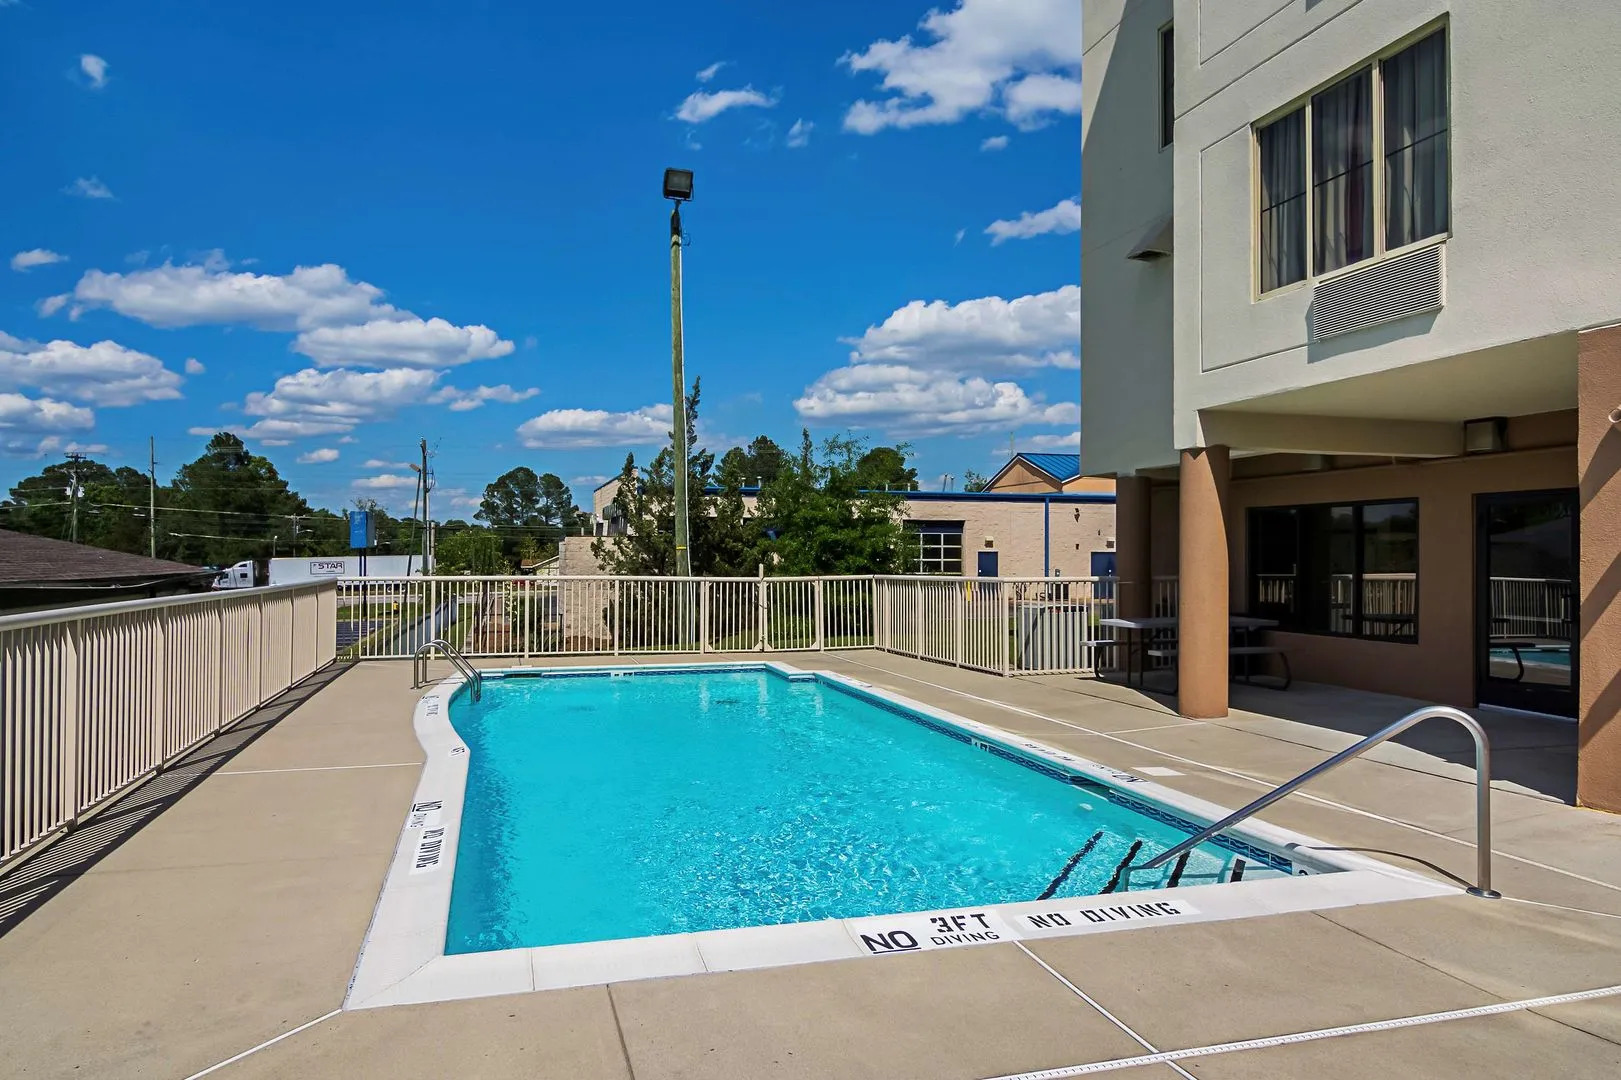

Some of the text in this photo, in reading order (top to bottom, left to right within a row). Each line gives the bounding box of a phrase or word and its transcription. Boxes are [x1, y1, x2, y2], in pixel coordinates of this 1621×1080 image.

[1027, 902, 1181, 929] NO DIVING
[860, 930, 1000, 951] NO DIVING
